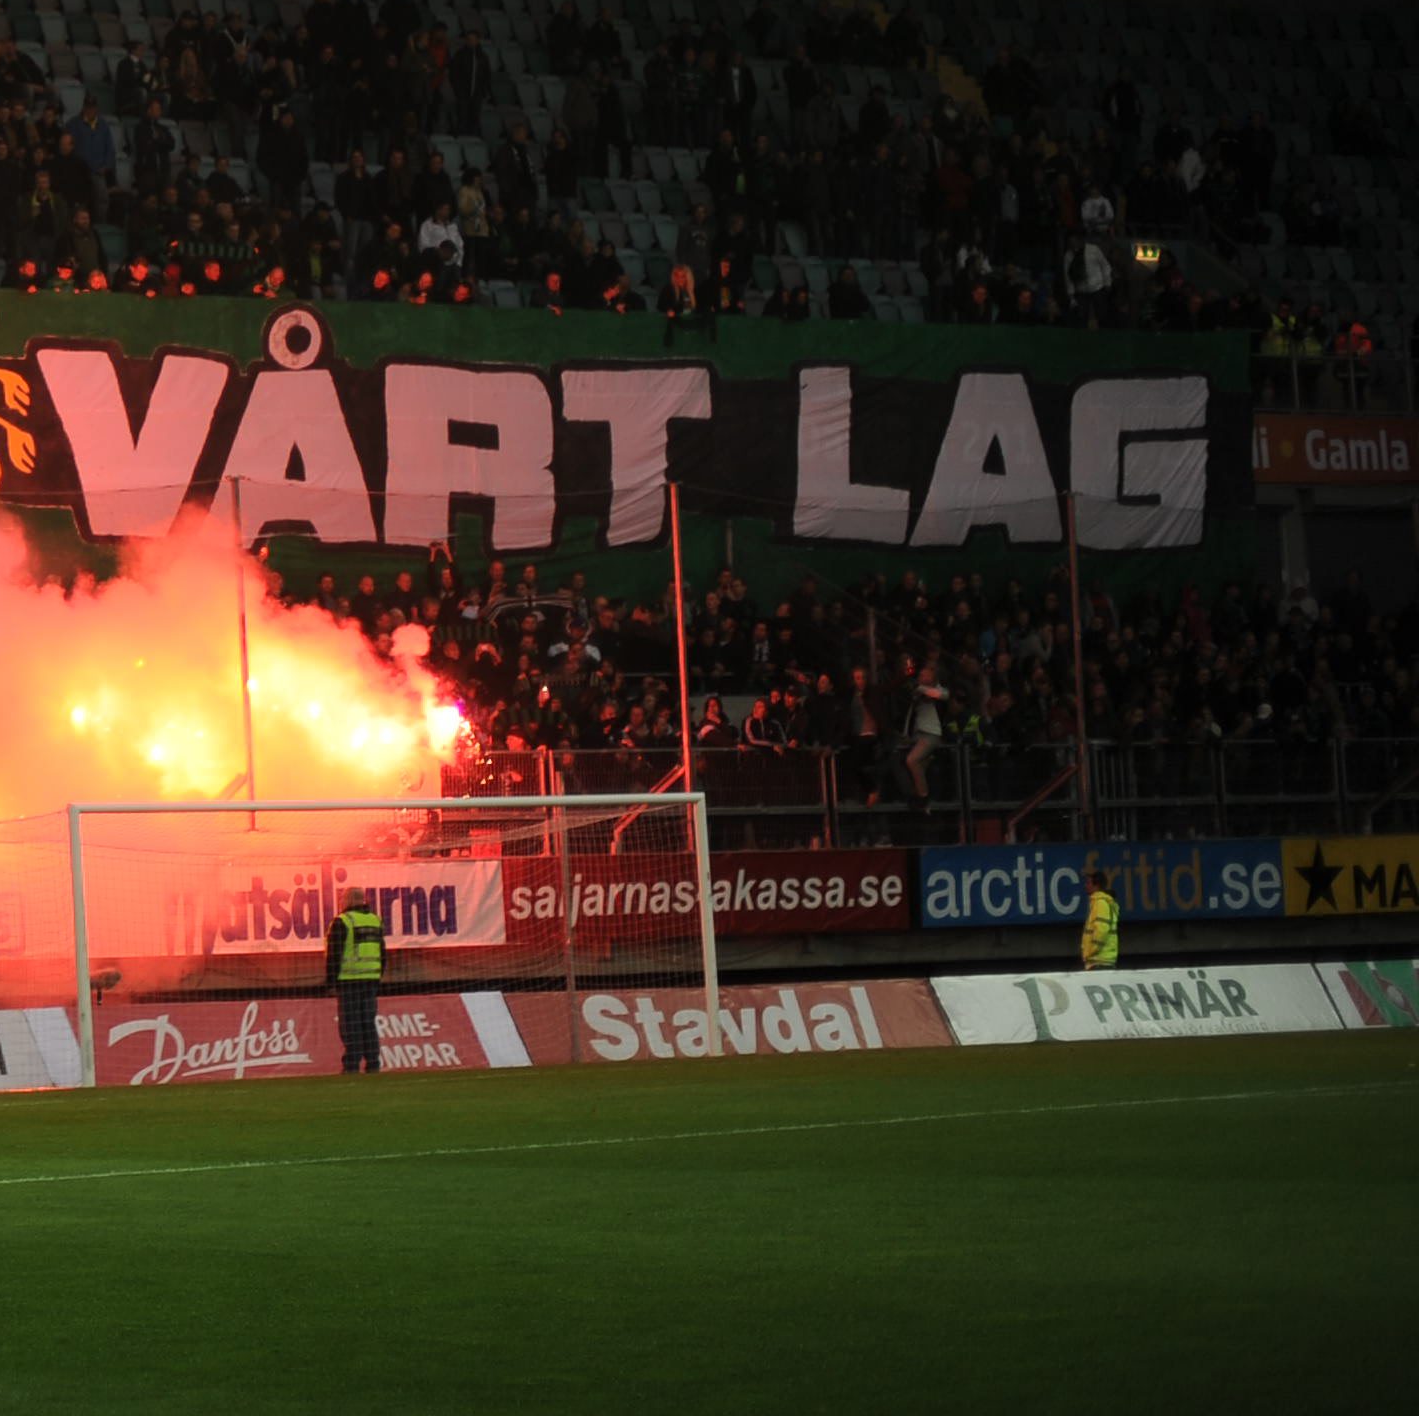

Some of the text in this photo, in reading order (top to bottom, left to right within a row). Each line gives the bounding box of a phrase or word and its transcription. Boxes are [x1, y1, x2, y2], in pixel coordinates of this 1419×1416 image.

[36, 305, 1209, 551] VÅRT LAG
[1305, 428, 1412, 472] Gamla
[509, 868, 903, 929] sajarnasakassa.se
[582, 986, 883, 1063] Stavdal
[1083, 969, 1260, 1023] PRIMÄR
[108, 1001, 312, 1084] Danfoss
